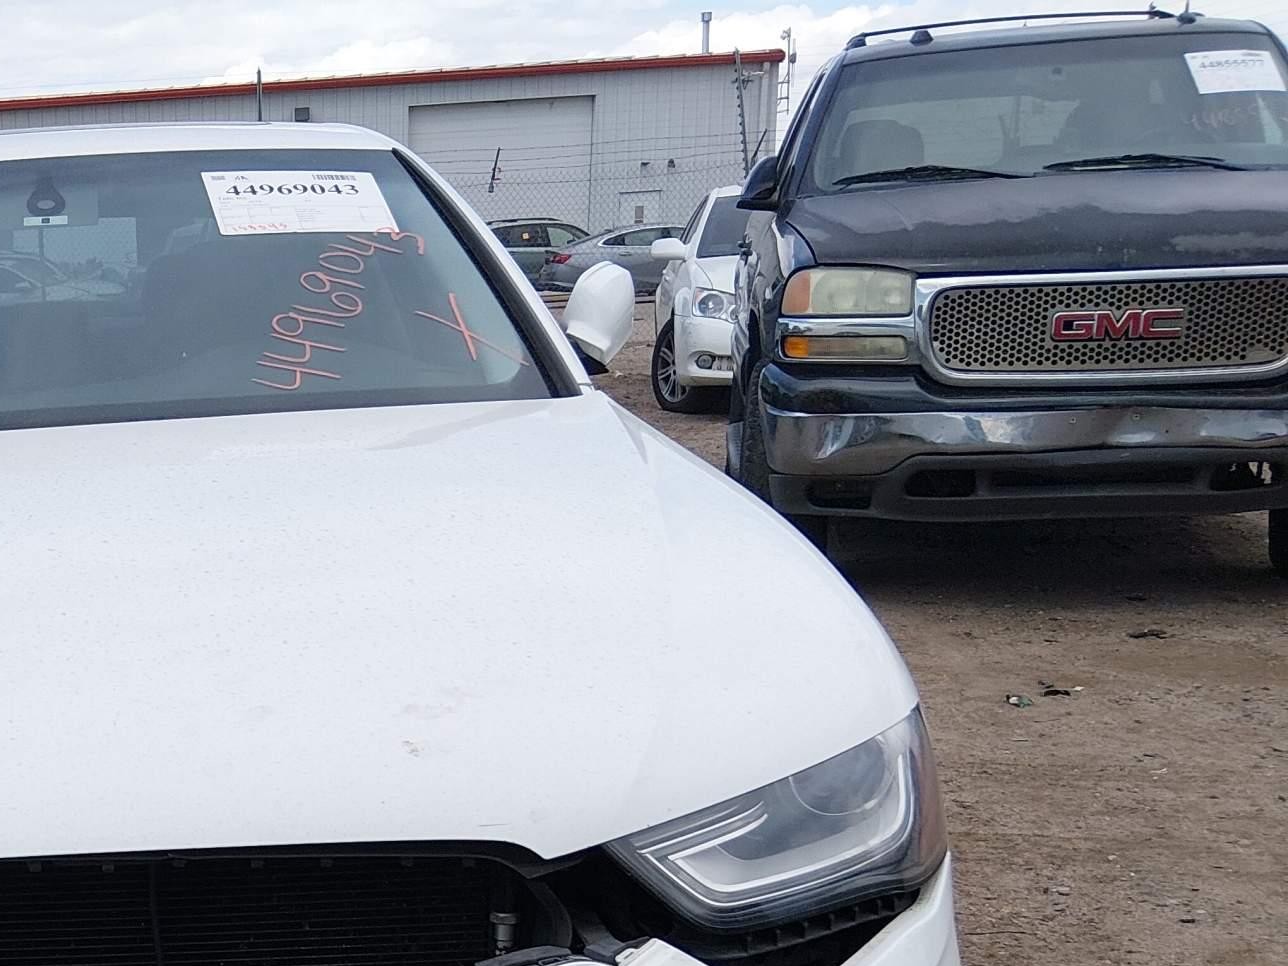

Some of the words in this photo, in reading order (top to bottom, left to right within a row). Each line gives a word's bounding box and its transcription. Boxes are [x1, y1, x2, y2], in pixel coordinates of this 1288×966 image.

[225, 183, 360, 196] 44969043
[251, 226, 425, 391] 44969043
[1051, 308, 1184, 341] GMC
